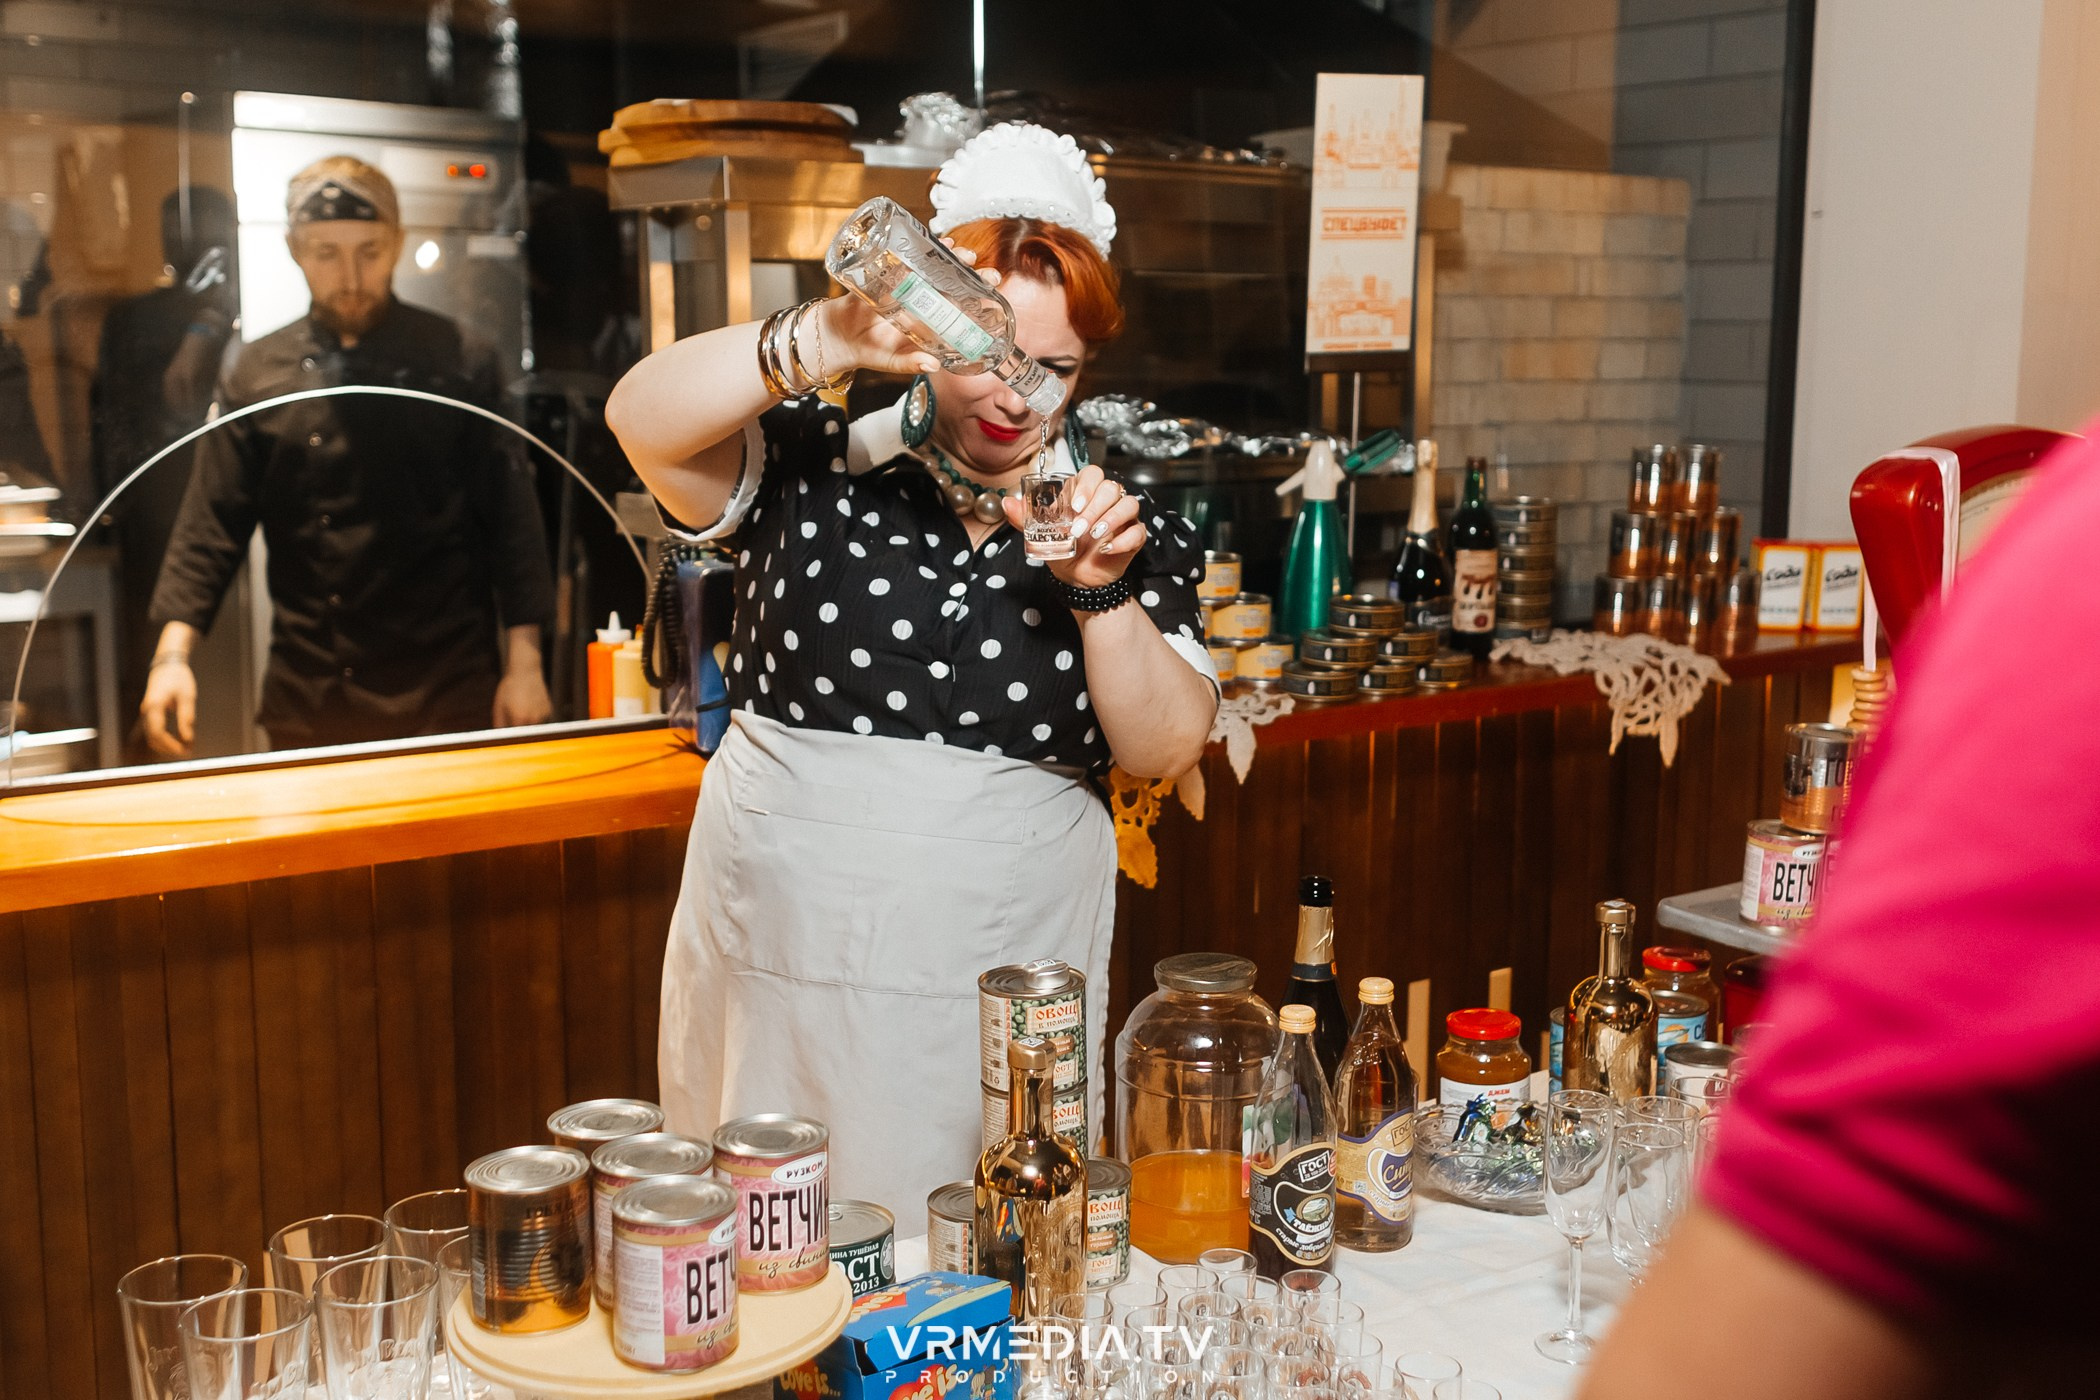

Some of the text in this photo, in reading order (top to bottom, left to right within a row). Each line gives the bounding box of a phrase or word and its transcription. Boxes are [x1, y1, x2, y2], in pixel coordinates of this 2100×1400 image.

[1036, 1005, 1077, 1020] ОВОЩ
[786, 1161, 823, 1179] РУЗКОМ
[1301, 1154, 1328, 1175] ГОСТ
[849, 1242, 879, 1257] ТУШЁНАЯ
[853, 1276, 880, 1294] 2013
